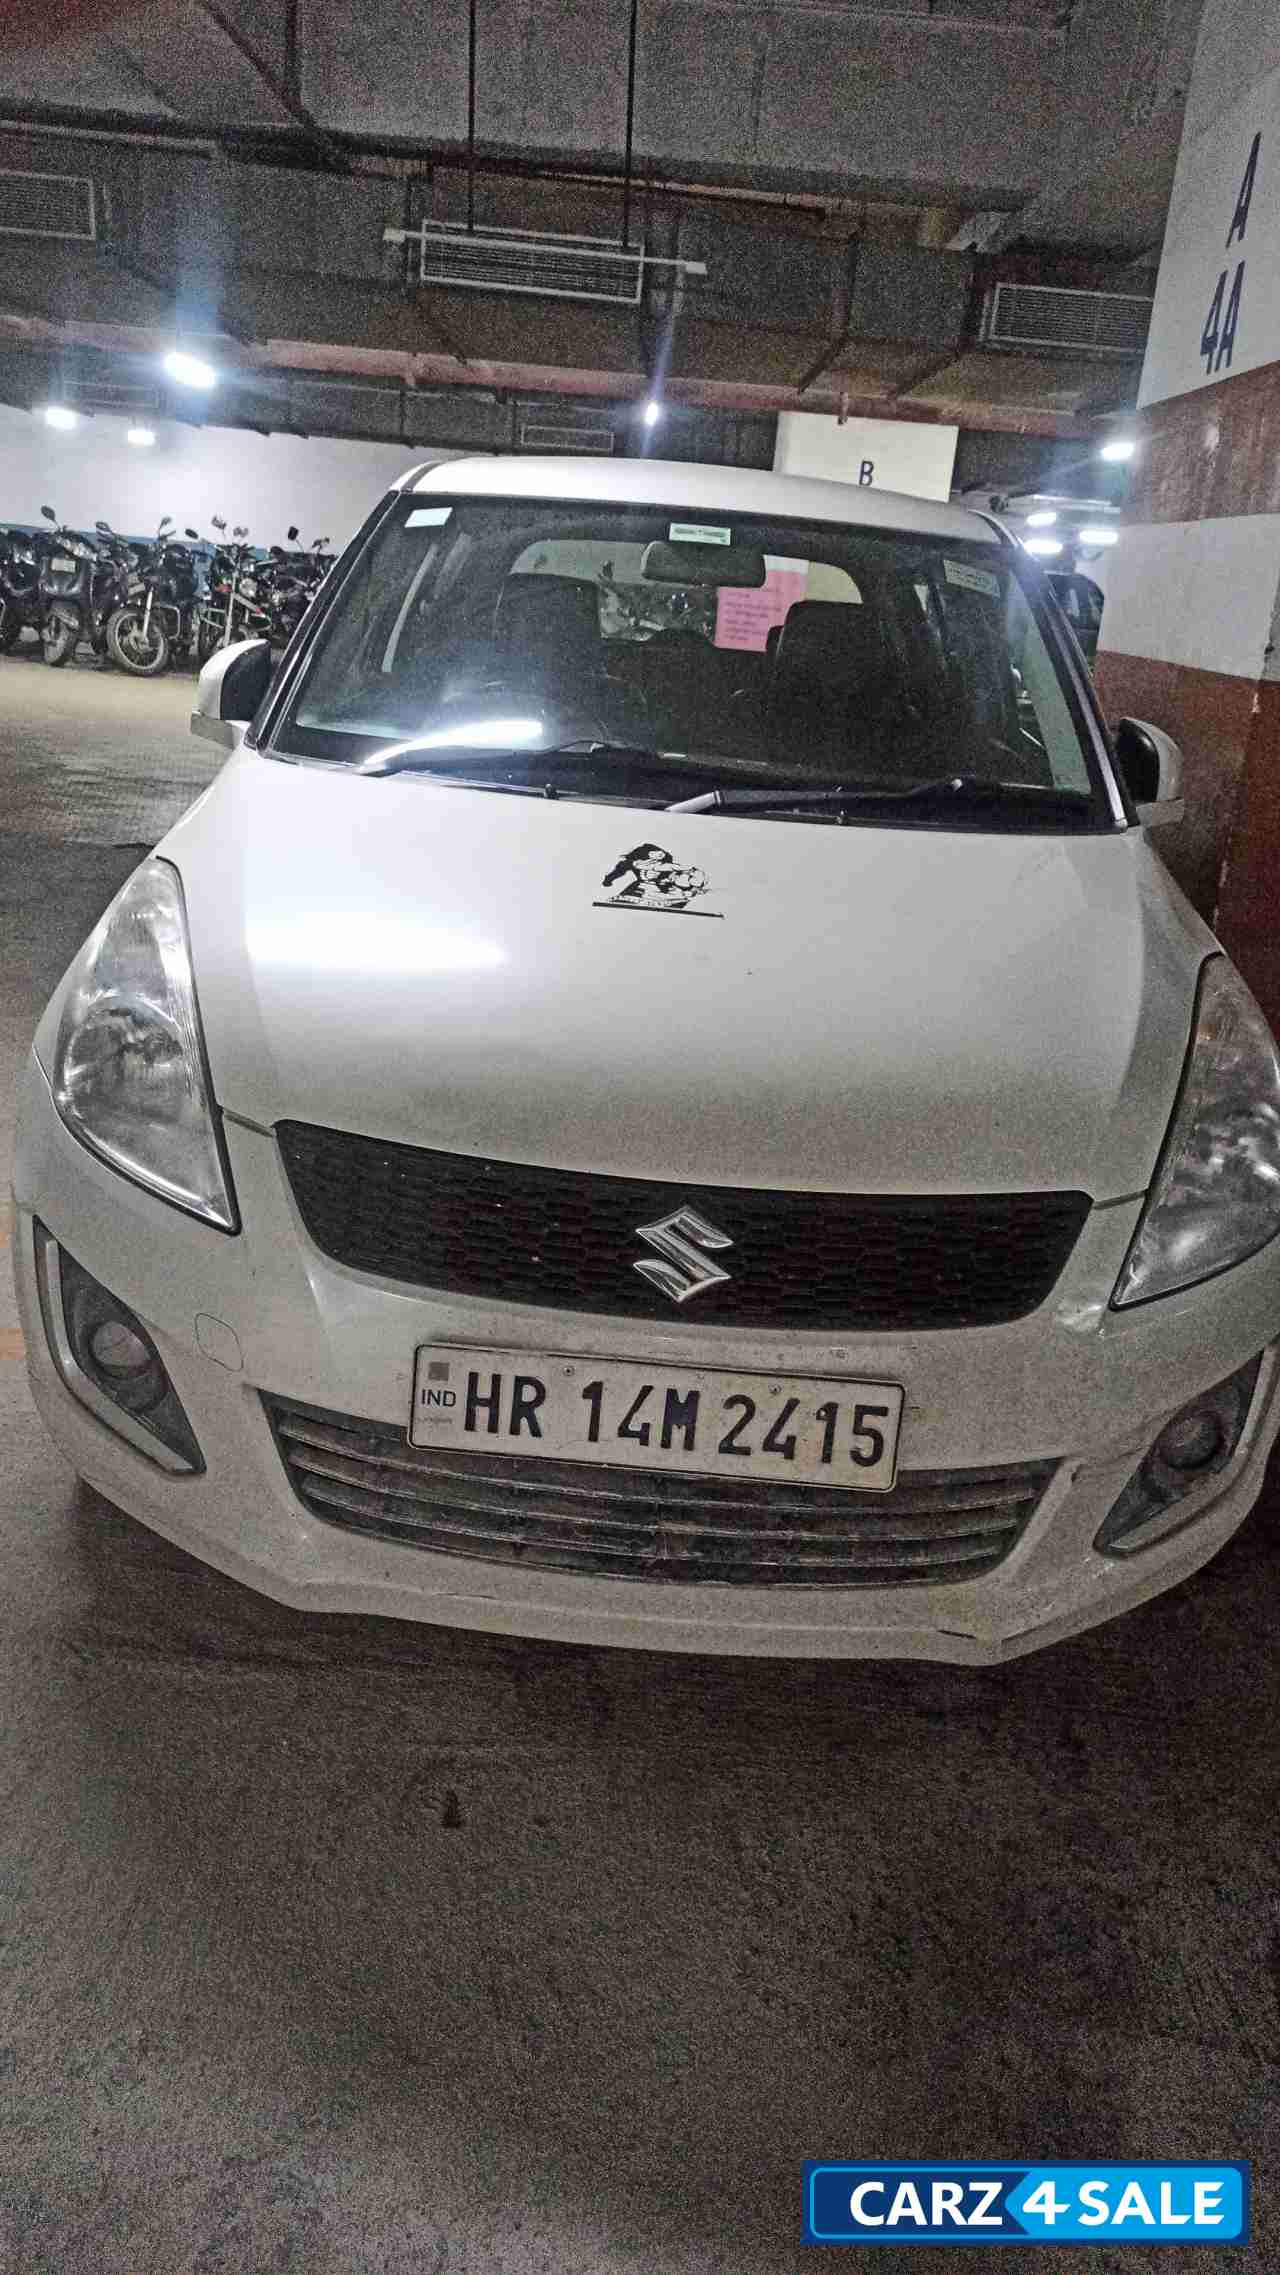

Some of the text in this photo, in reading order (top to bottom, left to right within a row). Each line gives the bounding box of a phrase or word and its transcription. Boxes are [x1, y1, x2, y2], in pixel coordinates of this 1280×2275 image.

[1226, 131, 1261, 249] A
[1200, 260, 1245, 375] 4A
[859, 460, 874, 487] B
[421, 1388, 457, 1407] IND
[464, 1371, 889, 1467] HR 14M 2415
